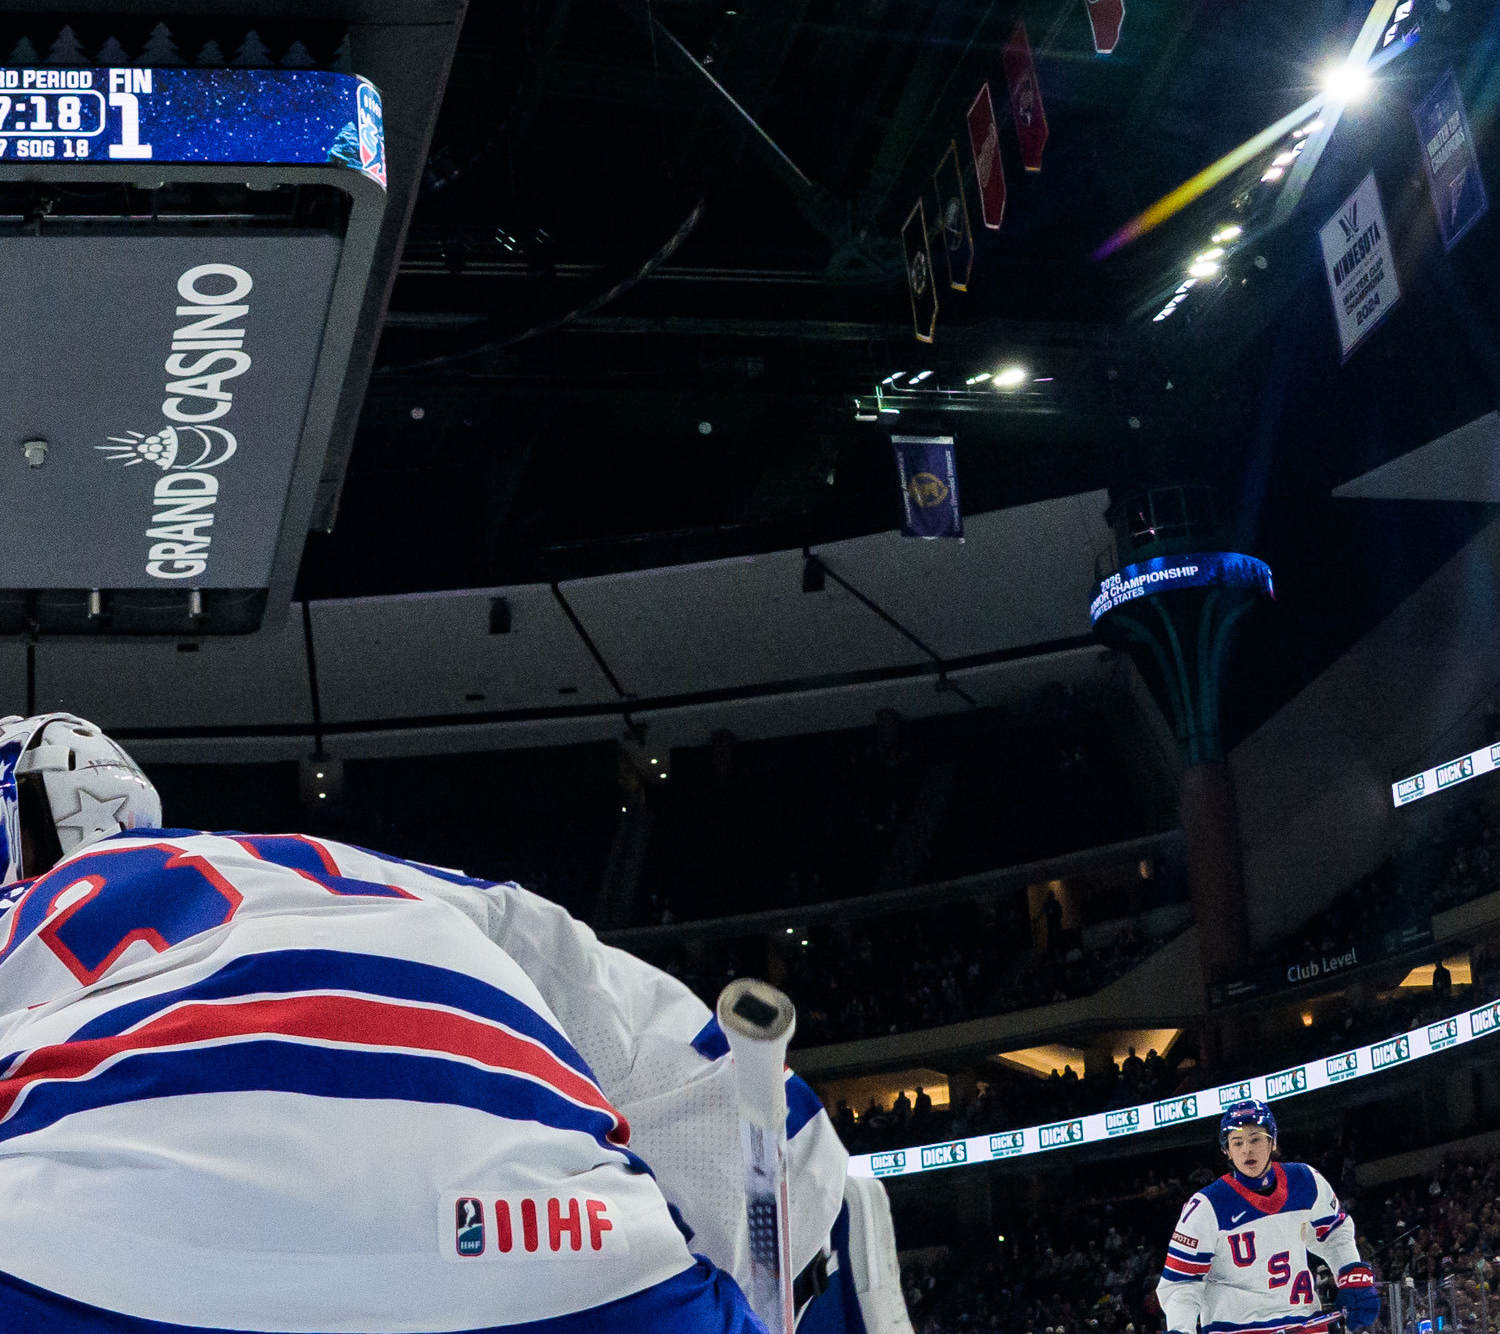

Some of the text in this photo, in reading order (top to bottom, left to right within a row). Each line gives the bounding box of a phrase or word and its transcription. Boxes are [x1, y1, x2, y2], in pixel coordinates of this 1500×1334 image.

[23, 70, 92, 89] PERIOD
[109, 69, 153, 94] FIN
[108, 95, 153, 159] 1
[17, 140, 56, 158] SOG
[62, 140, 89, 158] 18
[146, 264, 253, 580] GRAND CASINO
[1110, 565, 1199, 598] CHAMPIONSHIP
[1113, 587, 1145, 606] STATES
[1438, 758, 1471, 787] DICK'S
[1287, 947, 1358, 983] Club Level
[1372, 1038, 1408, 1069] DICK'S
[1267, 1070, 1306, 1097] DICK'S
[1041, 1122, 1082, 1146] DICK'S
[923, 1144, 966, 1167] DICK'S
[495, 1198, 613, 1252] IIHF
[1338, 1273, 1375, 1286] CCM
